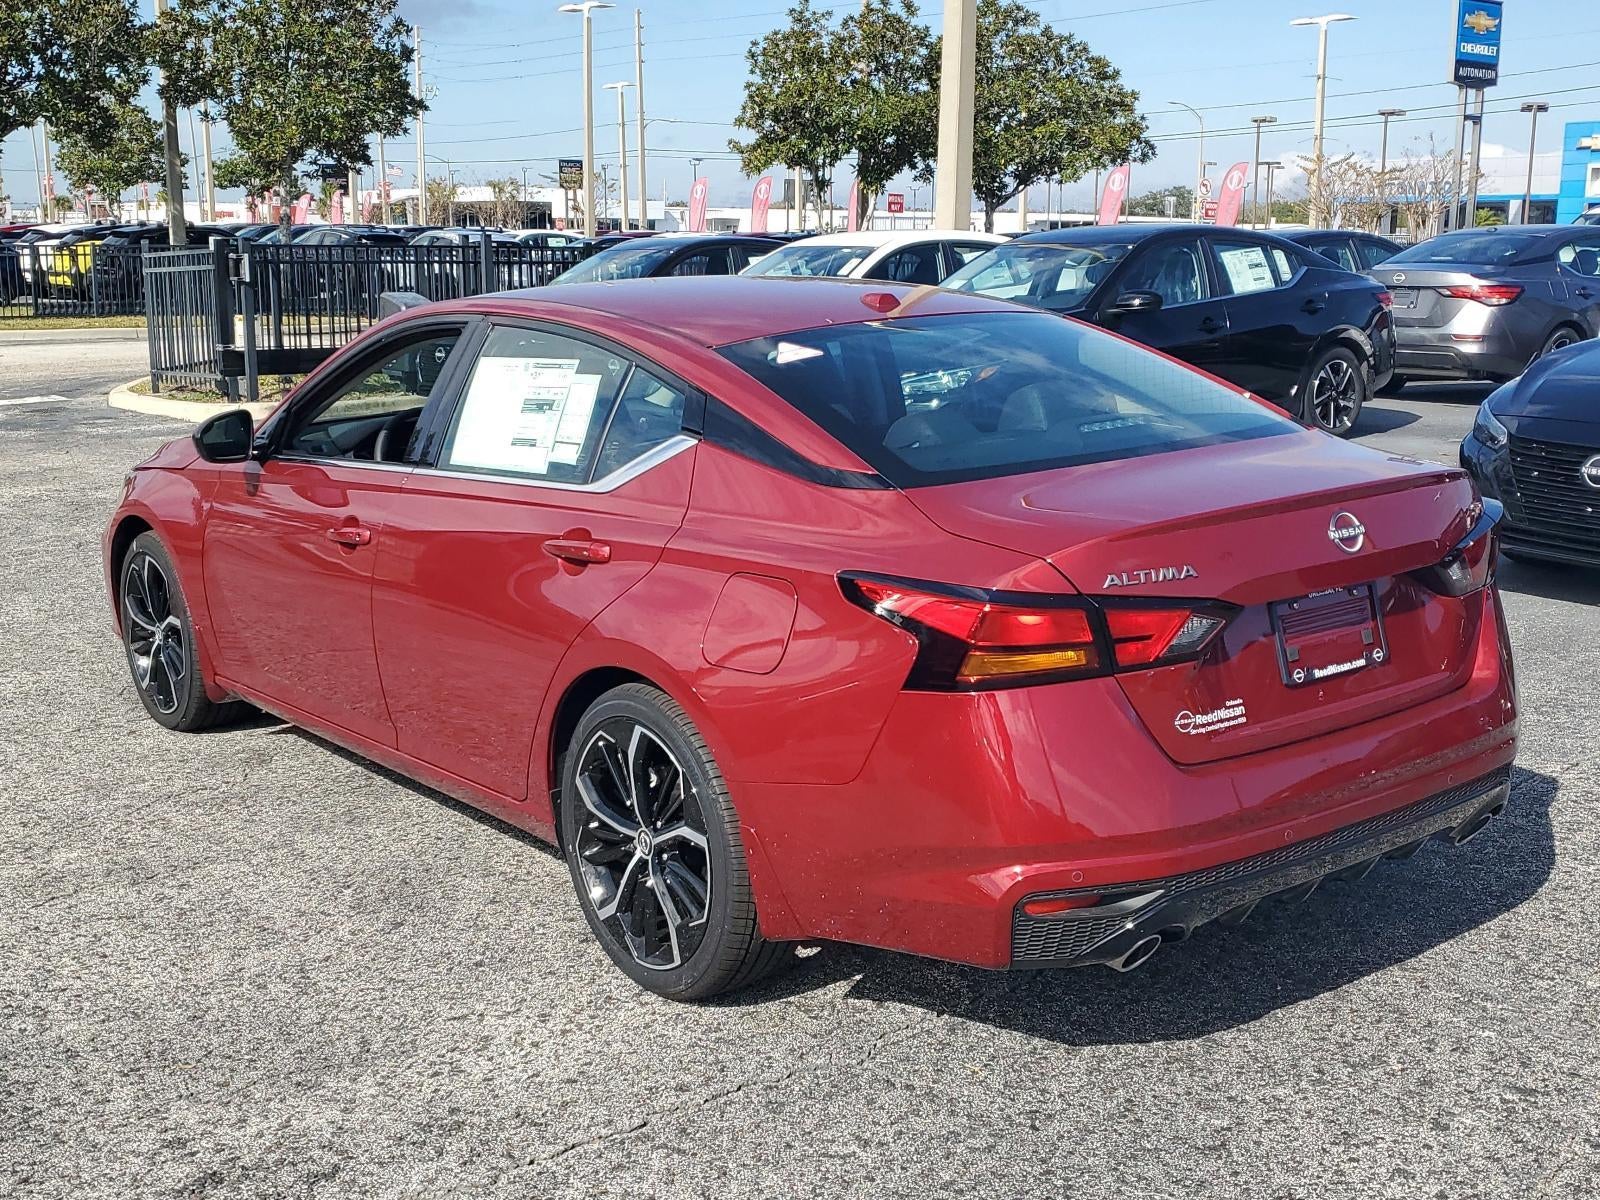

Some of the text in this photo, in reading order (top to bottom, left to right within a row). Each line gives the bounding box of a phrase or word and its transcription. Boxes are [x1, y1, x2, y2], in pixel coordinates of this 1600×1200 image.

[1461, 43, 1497, 56] CHEVROLET
[1459, 67, 1496, 79] AUTONATION
[1330, 525, 1365, 538] NISSAN
[1102, 565, 1199, 589] ALTIMA
[1313, 658, 1366, 678] ReedNissan.com
[1196, 705, 1245, 725] ReedNissan
